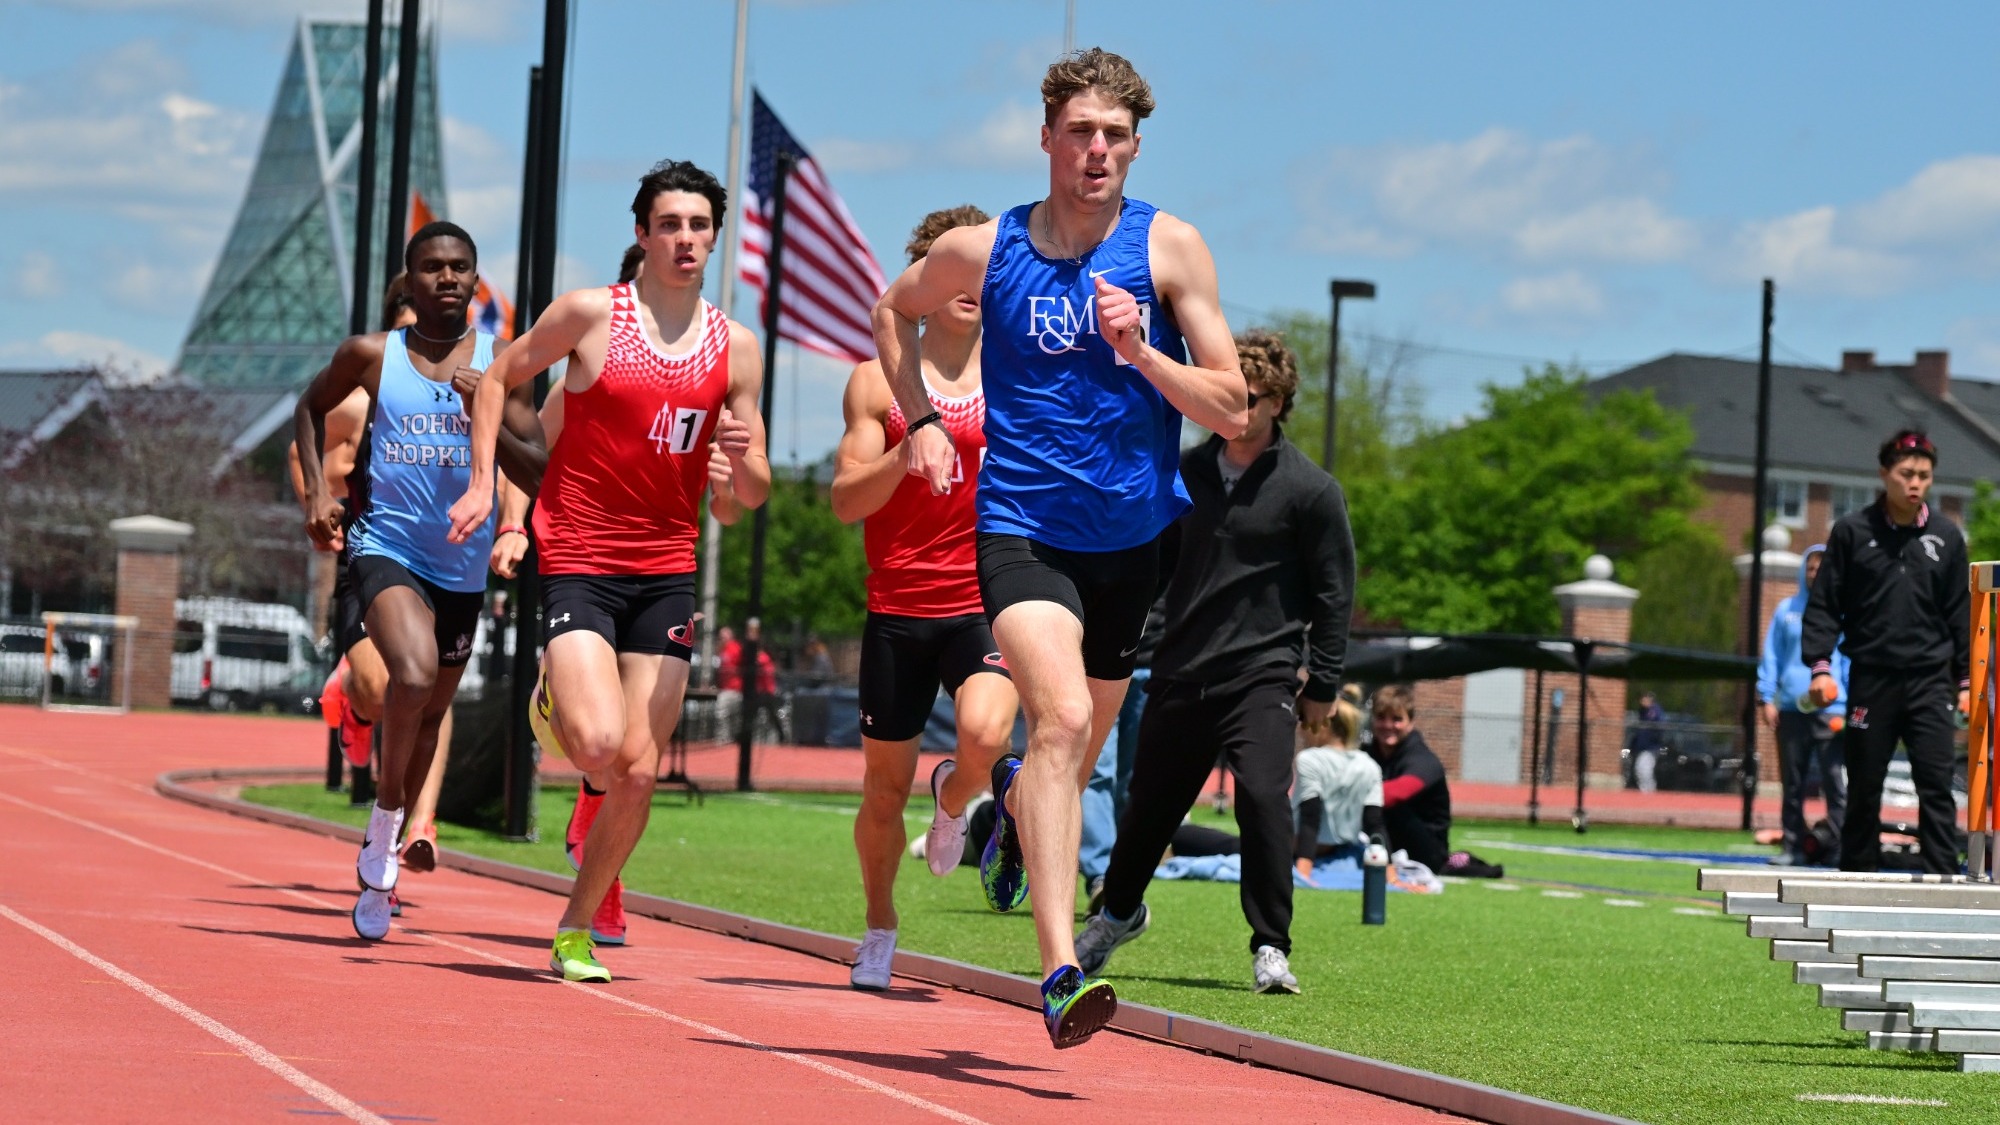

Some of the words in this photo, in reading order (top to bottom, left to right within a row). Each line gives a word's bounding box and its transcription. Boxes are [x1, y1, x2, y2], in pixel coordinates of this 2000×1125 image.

[1027, 296, 1098, 355] F&M
[400, 413, 470, 437] JOHN
[681, 413, 697, 450] 1
[384, 441, 471, 467] HOPKI
